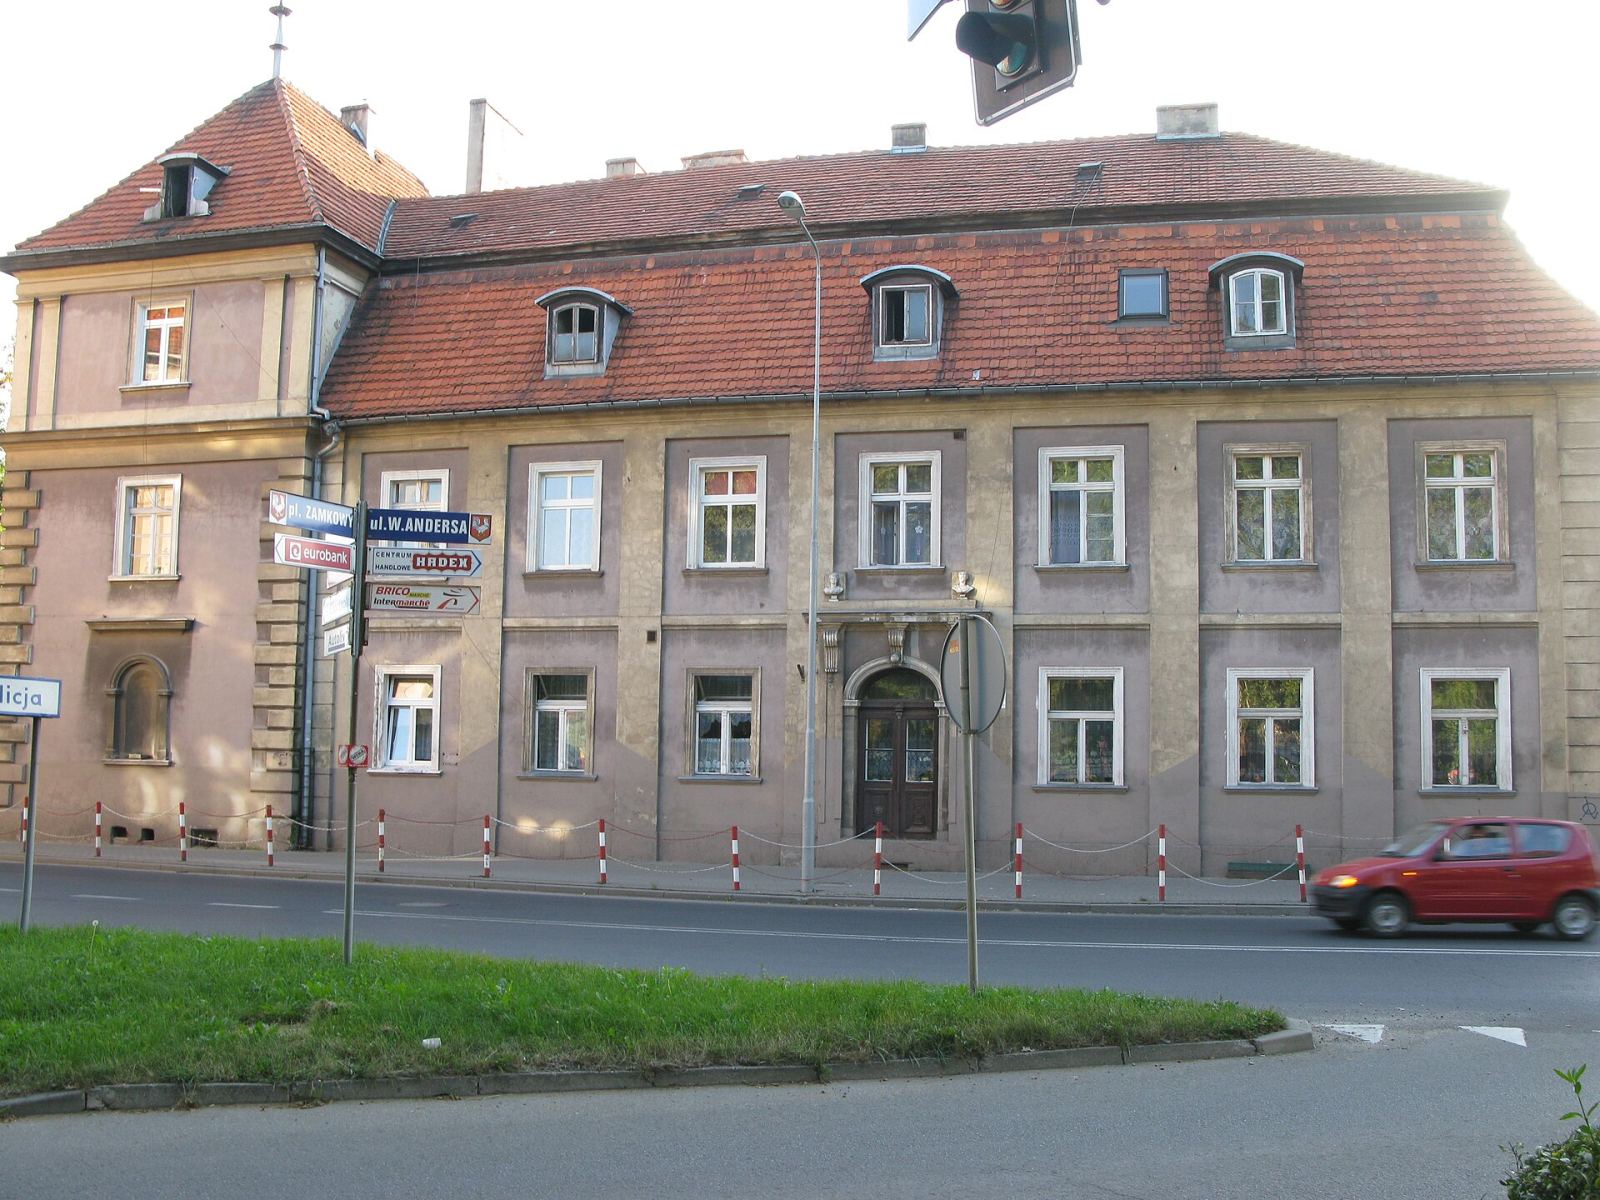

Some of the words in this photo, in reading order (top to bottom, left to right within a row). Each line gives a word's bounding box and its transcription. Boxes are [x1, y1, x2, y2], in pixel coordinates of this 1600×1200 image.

[288, 503, 302, 518] pl.
[306, 505, 353, 528] ZAMKOWY
[303, 547, 348, 564] eurobank
[376, 587, 411, 595] BRICO
